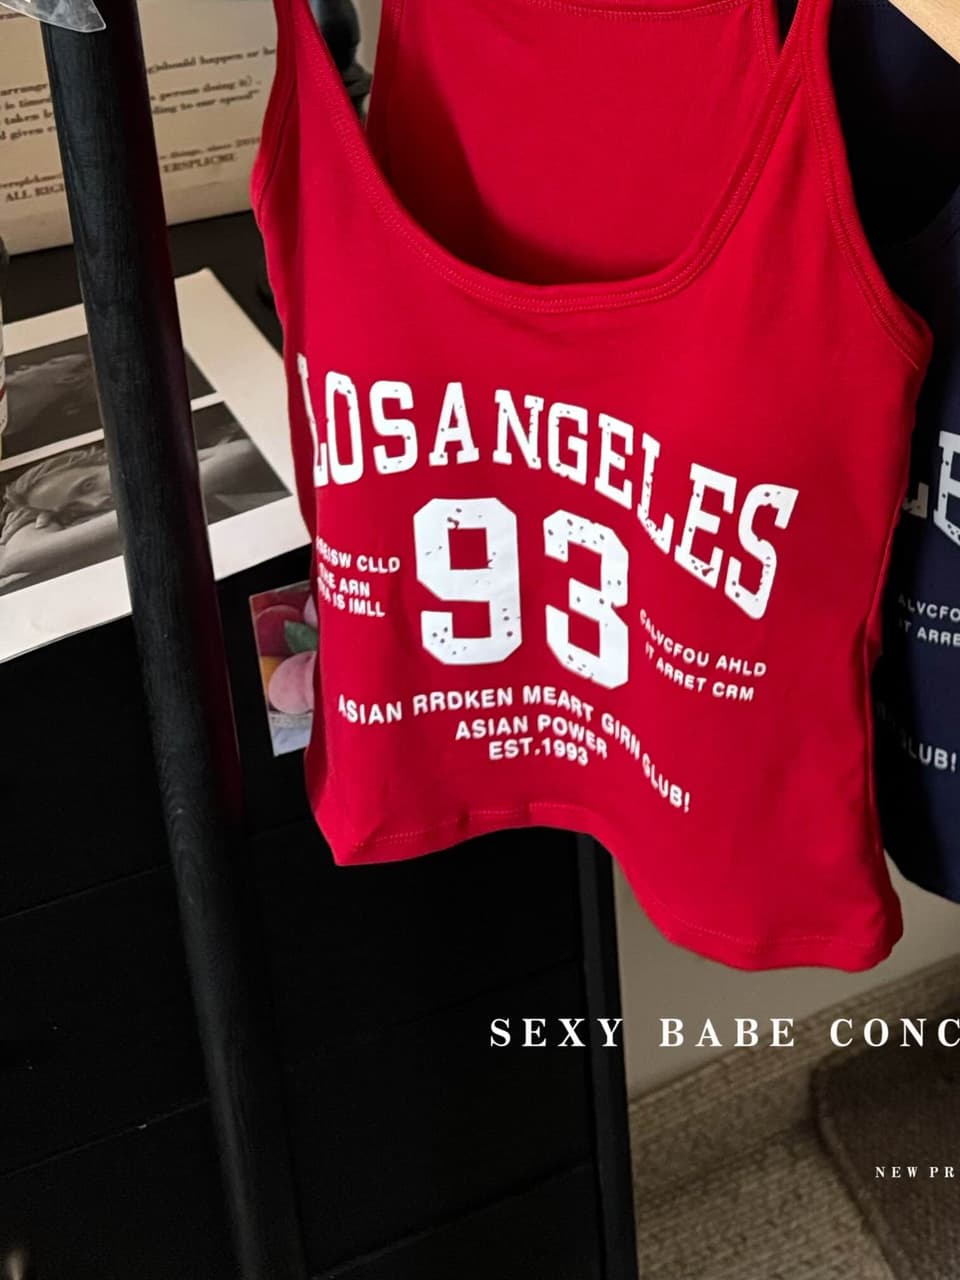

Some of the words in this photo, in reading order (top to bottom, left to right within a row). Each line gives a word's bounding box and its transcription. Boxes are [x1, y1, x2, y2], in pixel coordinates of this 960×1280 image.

[356, 554, 401, 574] CLLD
[339, 578, 371, 599] ARN
[413, 497, 630, 690] 93
[656, 656, 708, 694] ARRET
[712, 681, 755, 702] CRM
[715, 654, 768, 678] AHLD
[337, 693, 403, 725] ASIAN
[522, 685, 595, 724] MEART
[455, 715, 529, 742] ASIAN
[536, 713, 609, 760] POWER
[488, 737, 589, 767] EST.1993
